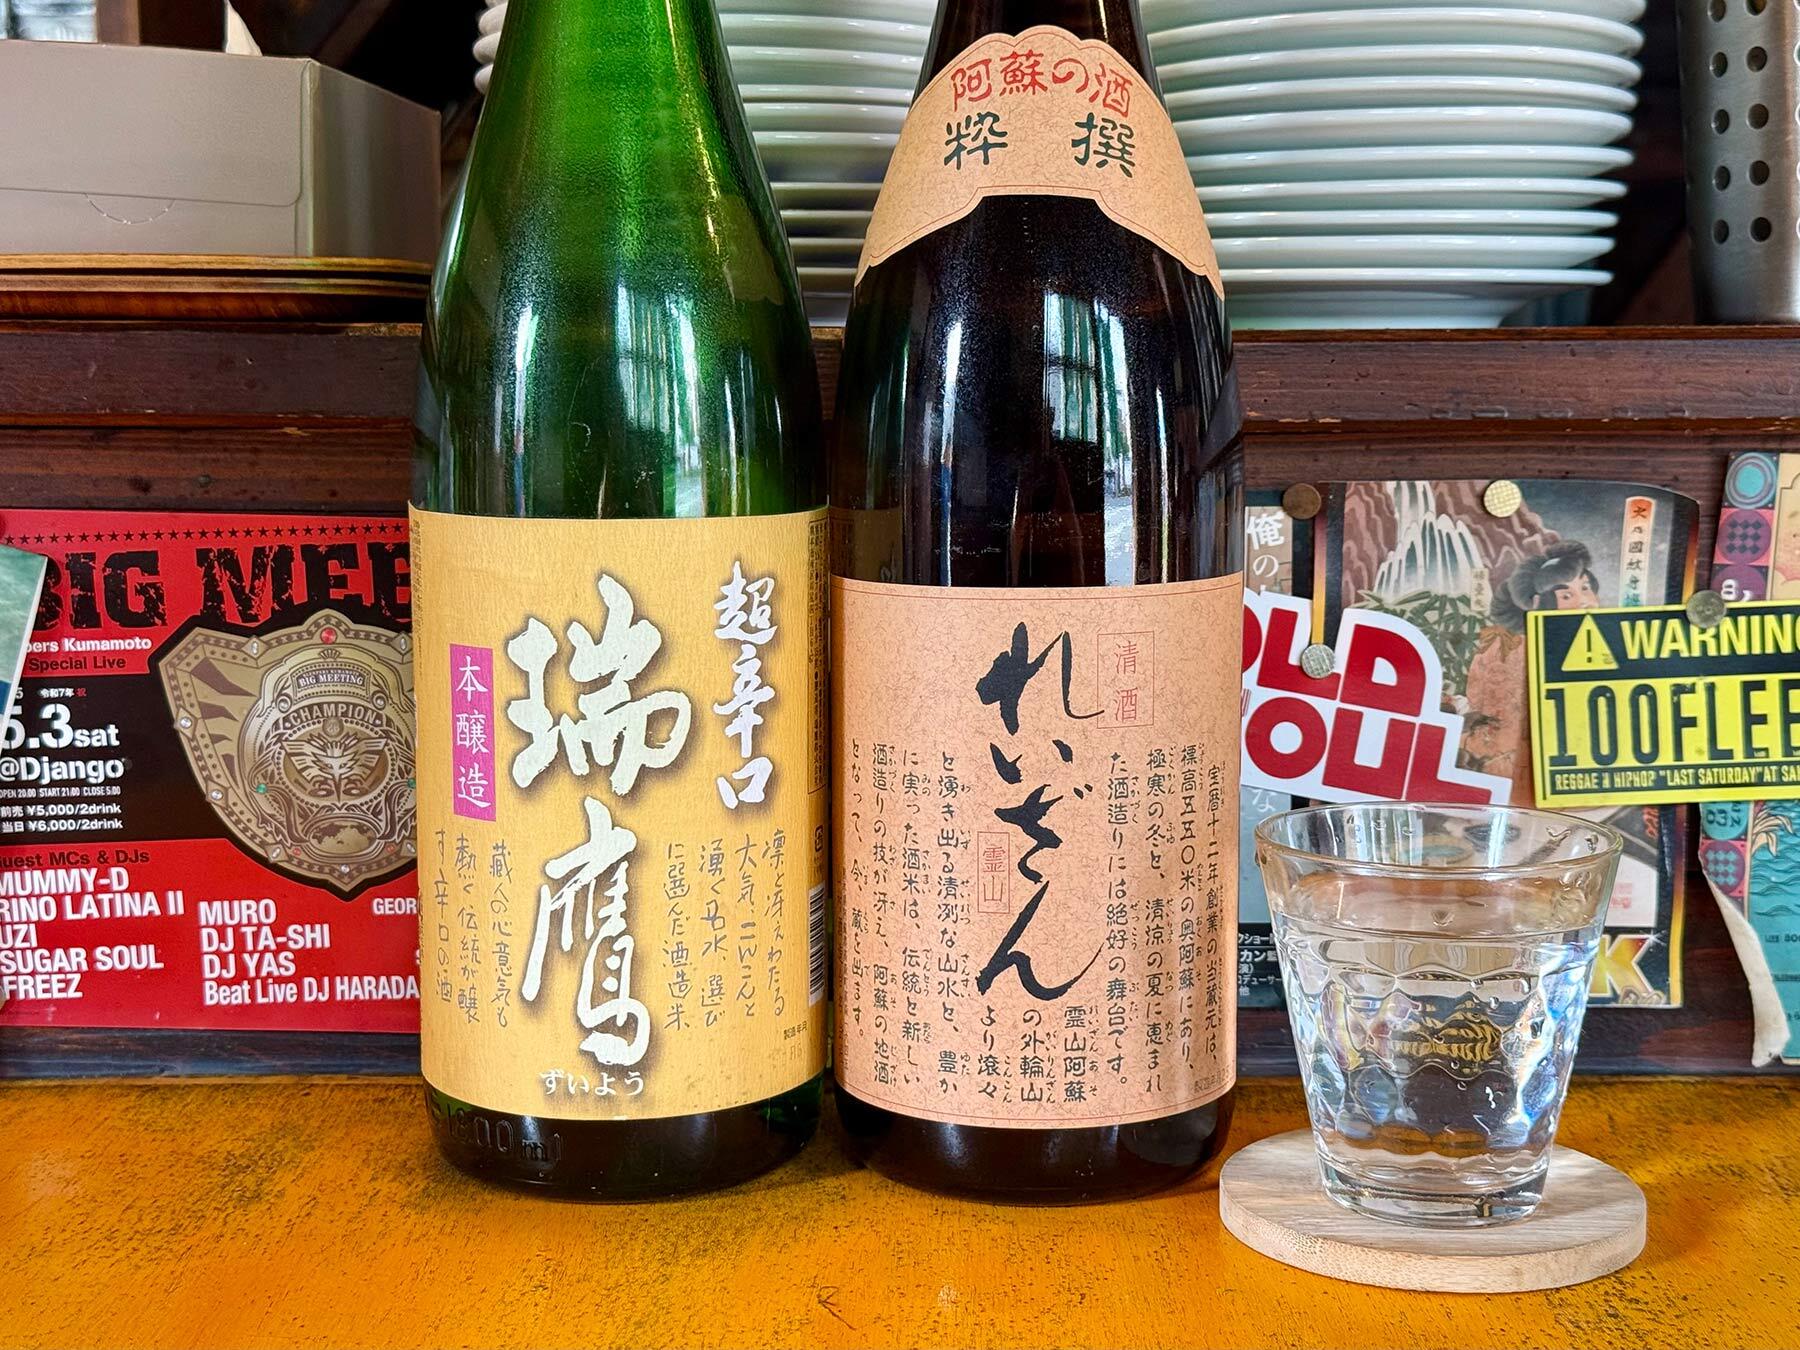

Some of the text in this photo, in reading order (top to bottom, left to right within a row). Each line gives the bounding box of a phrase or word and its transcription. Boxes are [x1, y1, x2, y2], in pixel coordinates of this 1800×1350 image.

[951, 49, 1133, 118] 阿蘇の酒
[1246, 511, 1285, 578] 俺の
[63, 637, 153, 650] Kumamoto
[1621, 614, 1800, 660] WARNIN
[28, 656, 126, 673] Special Live
[1243, 602, 1426, 716] LD
[712, 560, 780, 810] 超辛口
[1112, 640, 1139, 722] 清酒
[290, 703, 377, 724] CHAMPION
[455, 655, 492, 809] 本醸造
[0, 756, 126, 785] @Django
[1555, 773, 1598, 790] REGGAE
[1614, 770, 1655, 787] HIPHOP
[38, 787, 61, 797] START
[83, 786, 105, 796] CLOSE
[2, 821, 24, 833] 当日
[506, 573, 693, 1067] 瑞鷹
[49, 851, 90, 866] MCs
[97, 851, 109, 864] &
[116, 849, 150, 863] DJs
[0, 866, 130, 896] MUMMY-D
[982, 846, 1006, 902] 霊山
[0, 890, 185, 923] RINO LATINA II
[199, 899, 277, 926] MURO
[434, 828, 454, 1003] す辛口の酒
[1104, 751, 1128, 1085] た酒造りには絶好の舞台です。
[0, 923, 38, 949] UZI
[201, 924, 331, 952] DJ TA-SHI
[455, 833, 482, 1024] 熱く伝統が醸
[489, 839, 514, 1028] 蔵人の心意気も
[0, 944, 164, 974] SUGAR SOUL
[203, 951, 296, 979] DJ YAS
[204, 974, 420, 1006] Beat Live DJ HARADA
[1019, 1009, 1045, 1102] の外輪山
[1063, 1005, 1087, 1103] 霊山阿蘇
[539, 1068, 645, 1096] ずいよう
